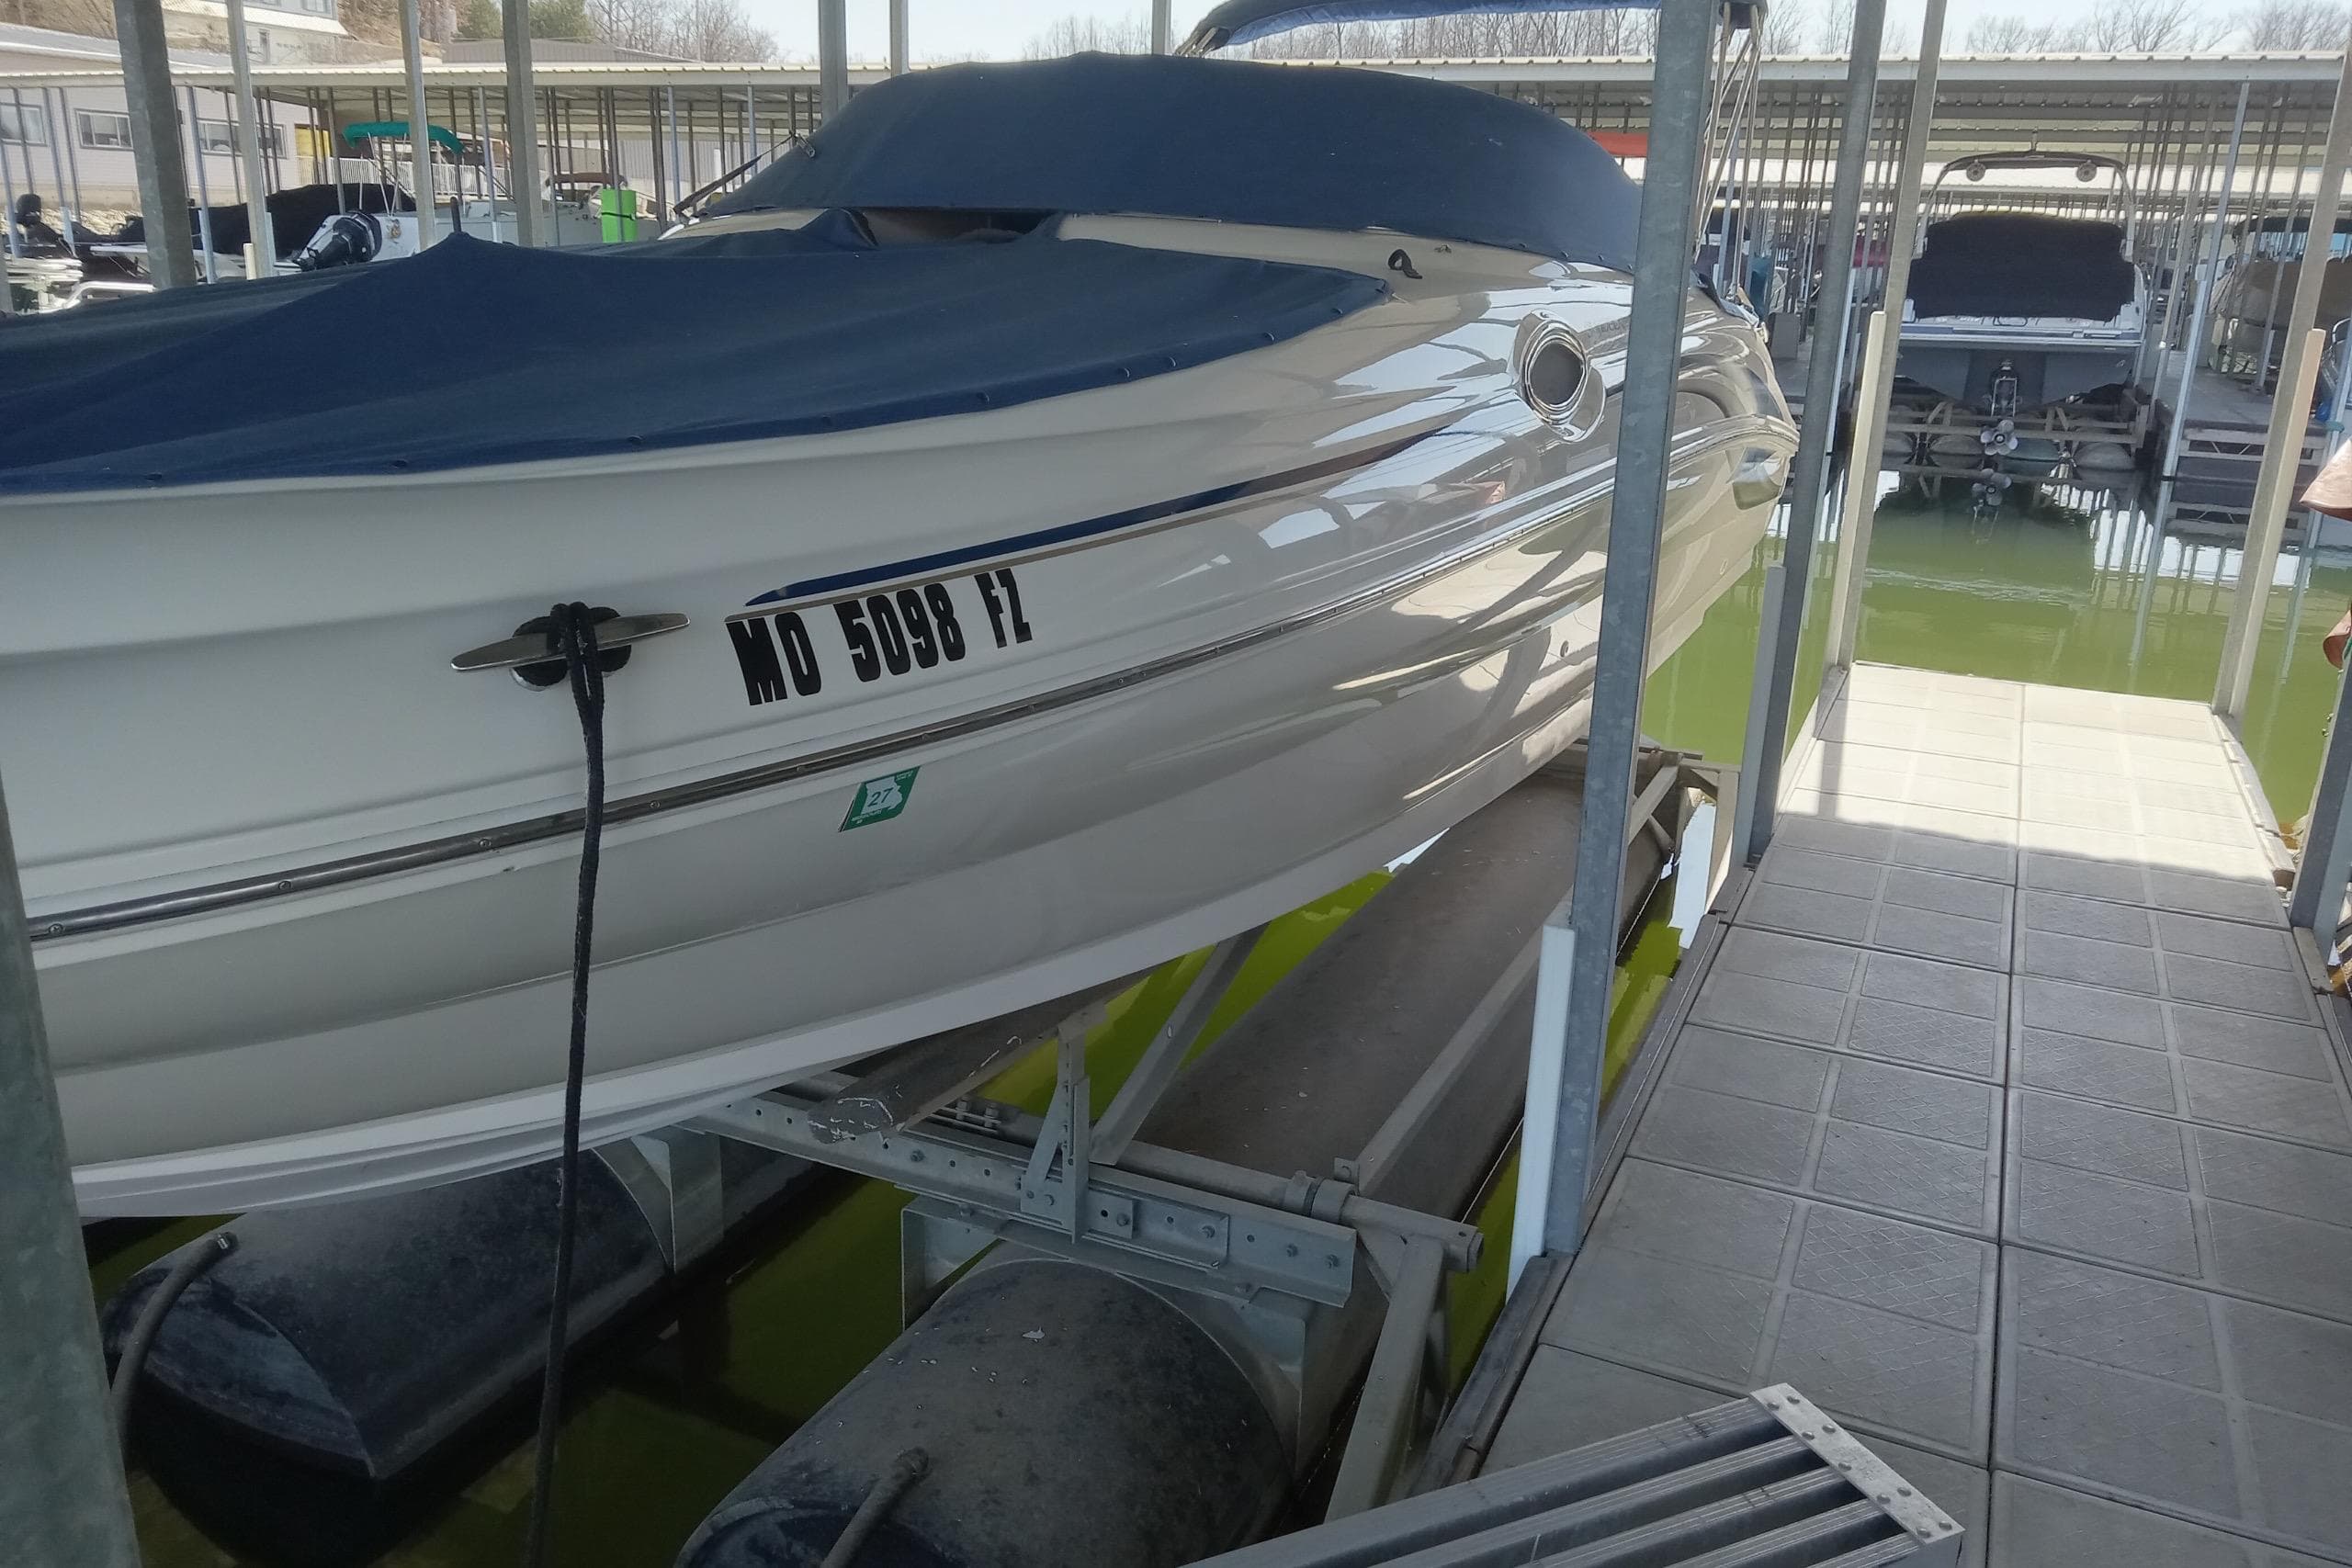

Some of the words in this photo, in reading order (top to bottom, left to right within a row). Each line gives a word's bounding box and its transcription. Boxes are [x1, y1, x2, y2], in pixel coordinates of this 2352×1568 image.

[726, 611, 821, 705] MO
[833, 581, 966, 682] 5098
[974, 568, 1033, 649] FZ
[867, 787, 894, 807] 27
